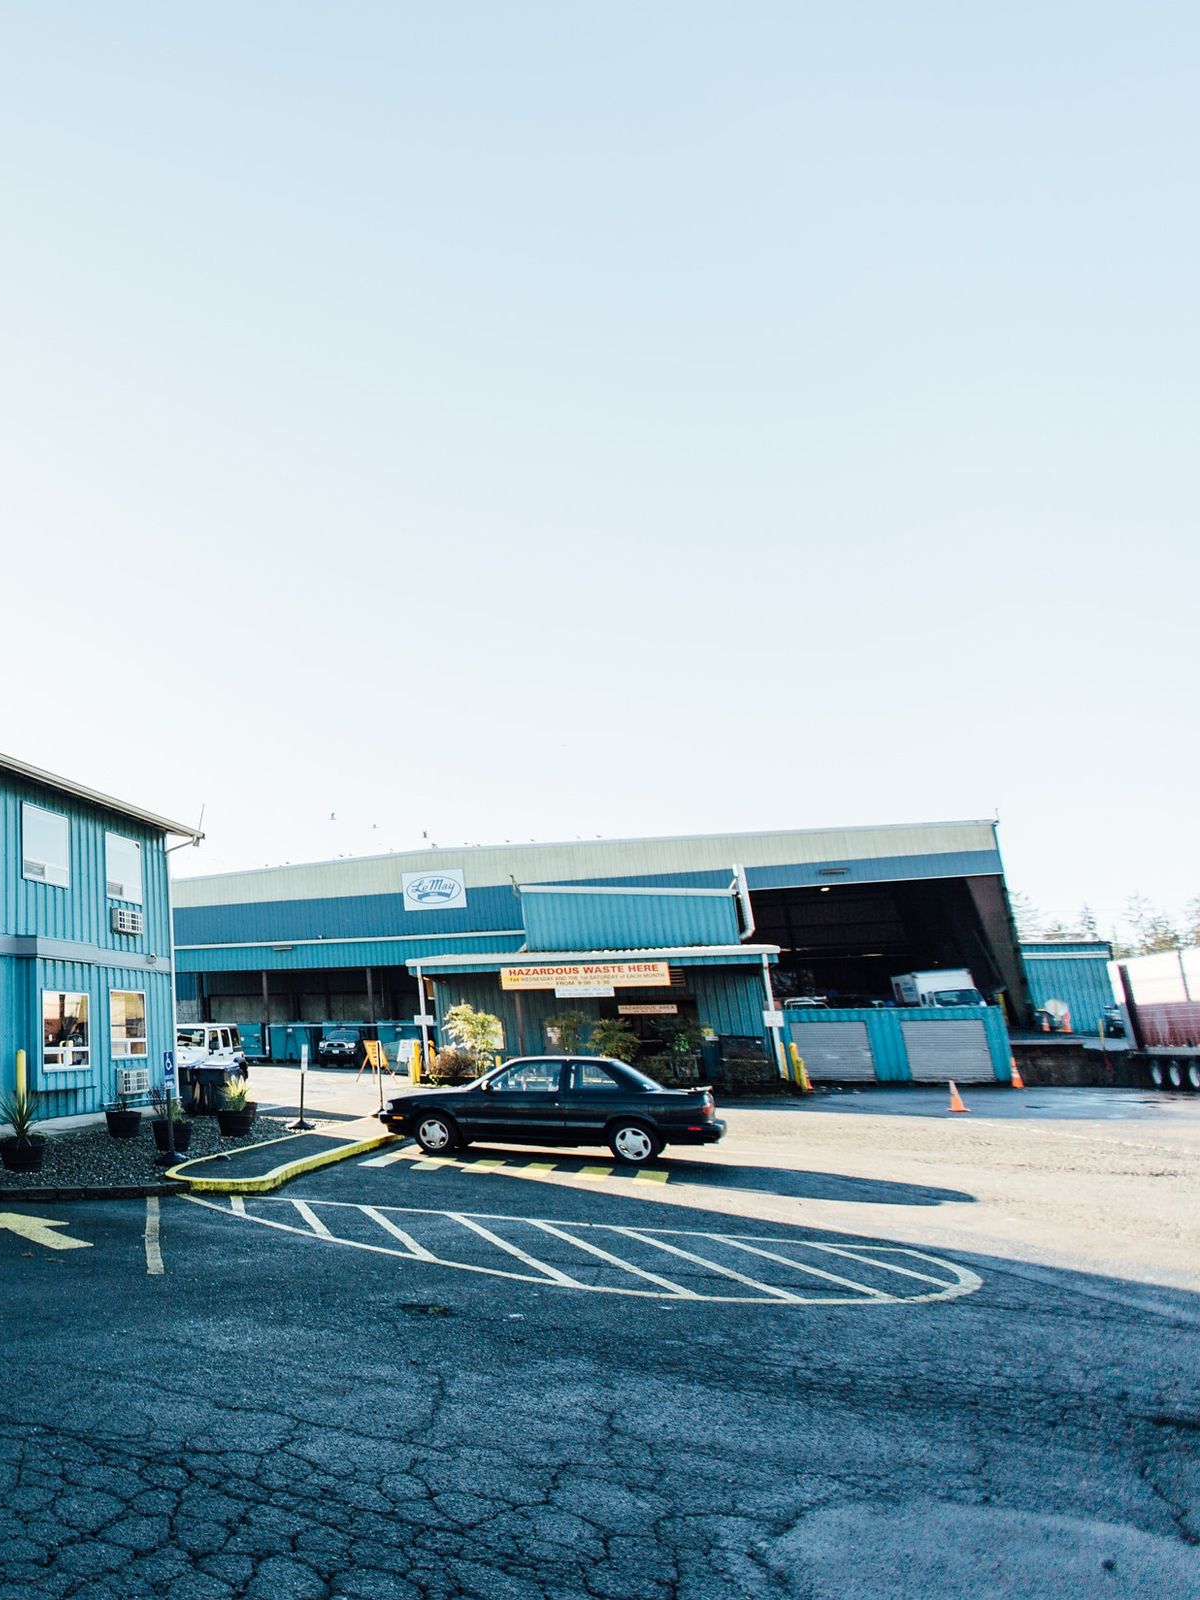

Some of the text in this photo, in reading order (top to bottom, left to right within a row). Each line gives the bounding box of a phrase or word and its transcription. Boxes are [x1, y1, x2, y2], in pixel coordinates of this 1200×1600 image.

[509, 964, 659, 977] HAZARDOUS WASTE HERE
